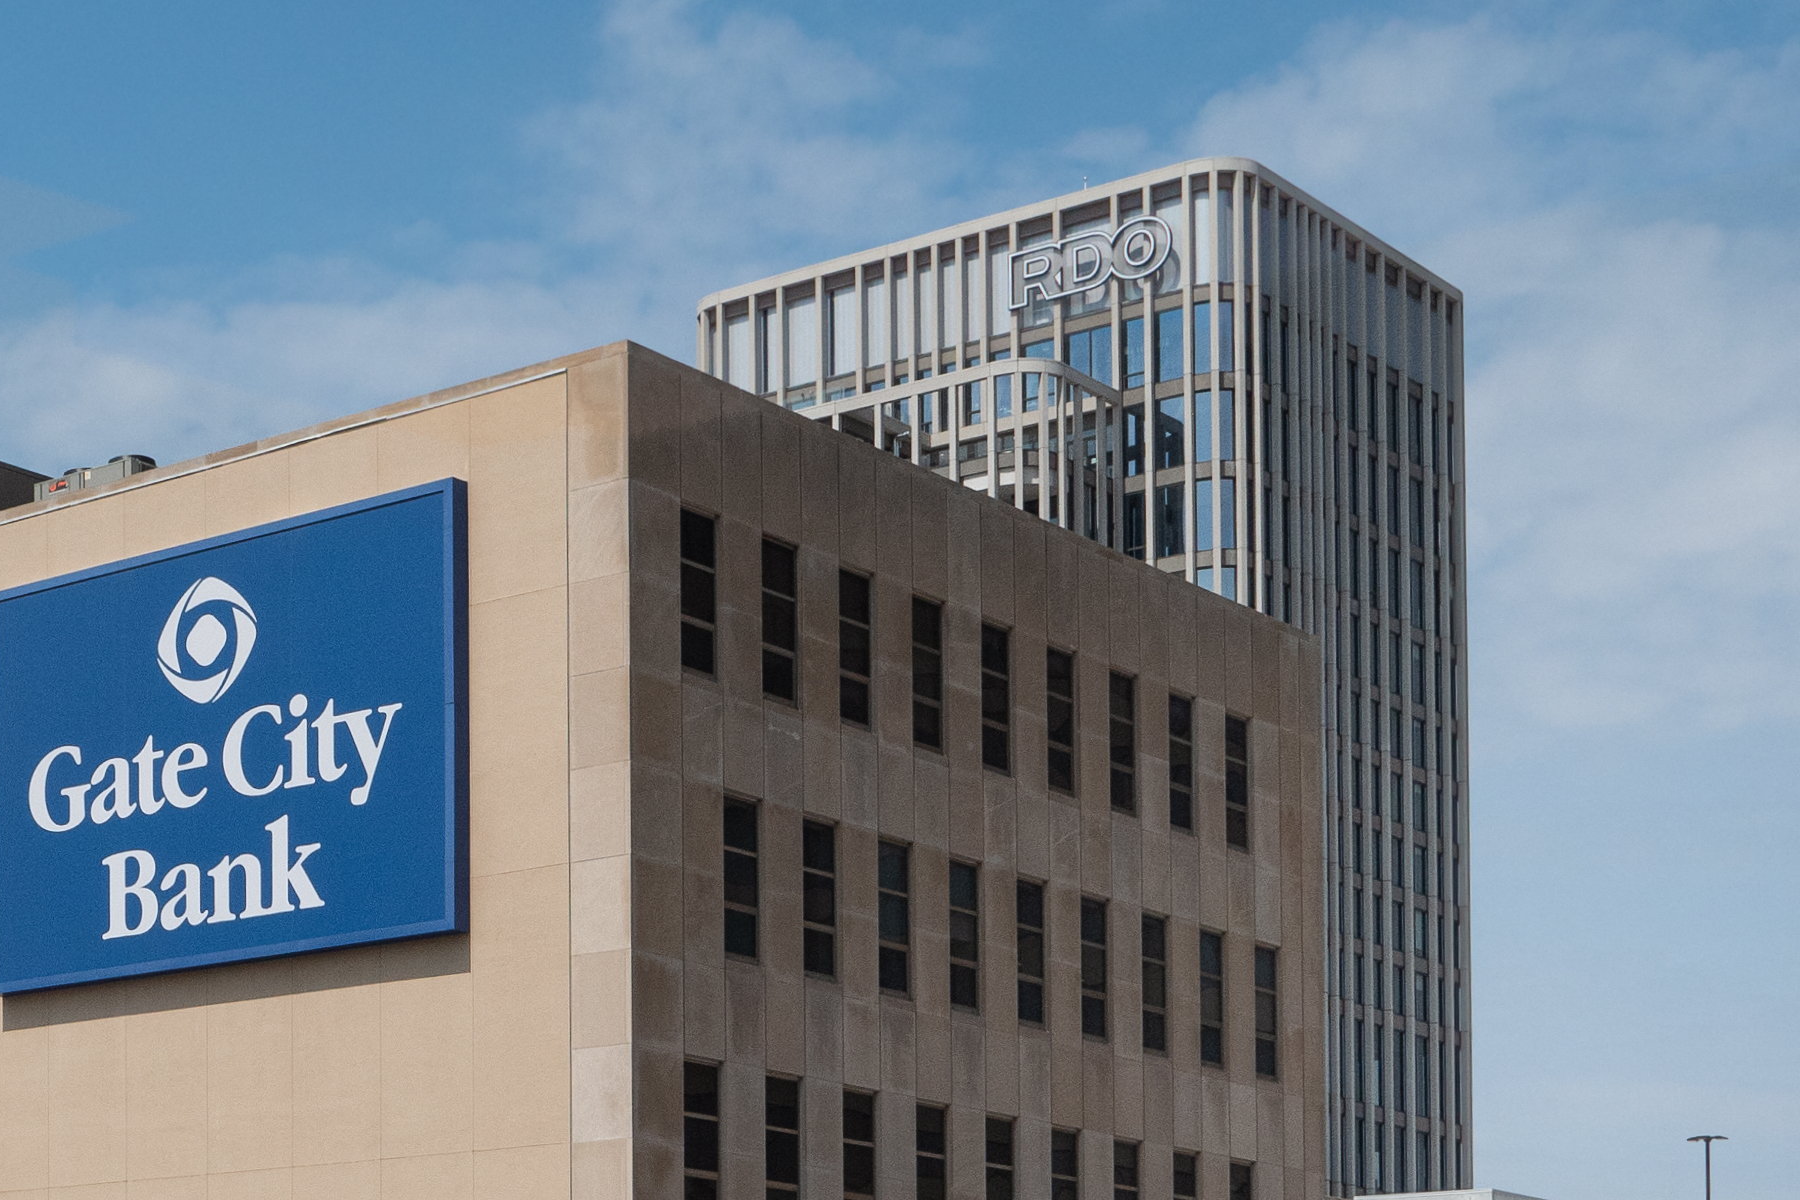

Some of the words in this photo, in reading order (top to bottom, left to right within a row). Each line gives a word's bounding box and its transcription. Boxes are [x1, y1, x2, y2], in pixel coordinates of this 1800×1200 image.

[1008, 215, 1172, 310] RDO
[28, 735, 208, 832] Gate
[223, 694, 402, 805] City
[102, 815, 325, 940] Bank
